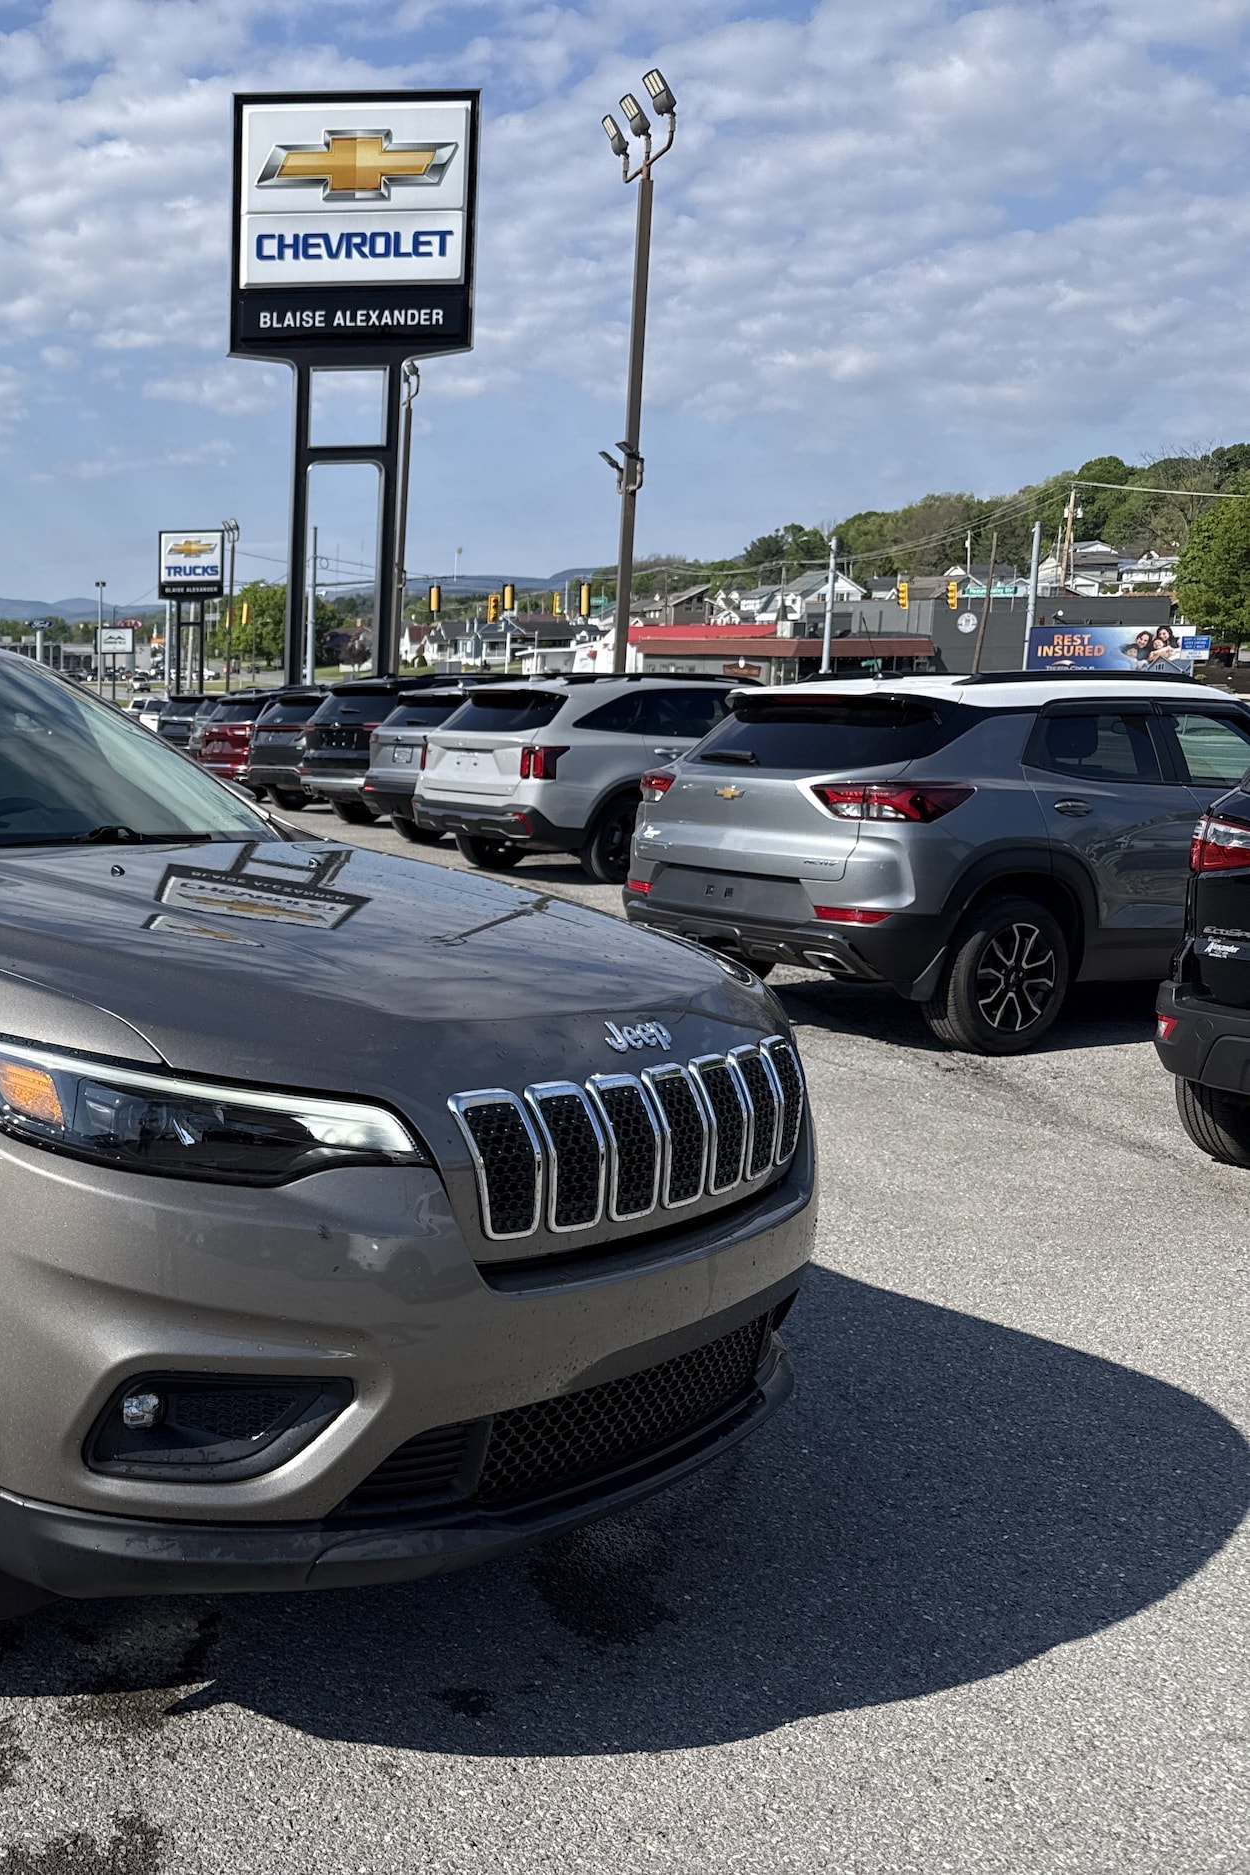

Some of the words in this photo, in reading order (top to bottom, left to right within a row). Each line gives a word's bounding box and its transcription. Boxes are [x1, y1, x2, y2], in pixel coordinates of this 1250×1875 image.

[256, 230, 454, 261] CHEVROLET
[259, 311, 326, 328] BLAISE
[333, 309, 444, 326] ALEXANDER
[166, 565, 219, 577] TRUCKS
[164, 586, 185, 594] BLAISE
[1053, 633, 1092, 646] REST
[1037, 645, 1106, 657] INSURED
[604, 1020, 672, 1053] Jeep
